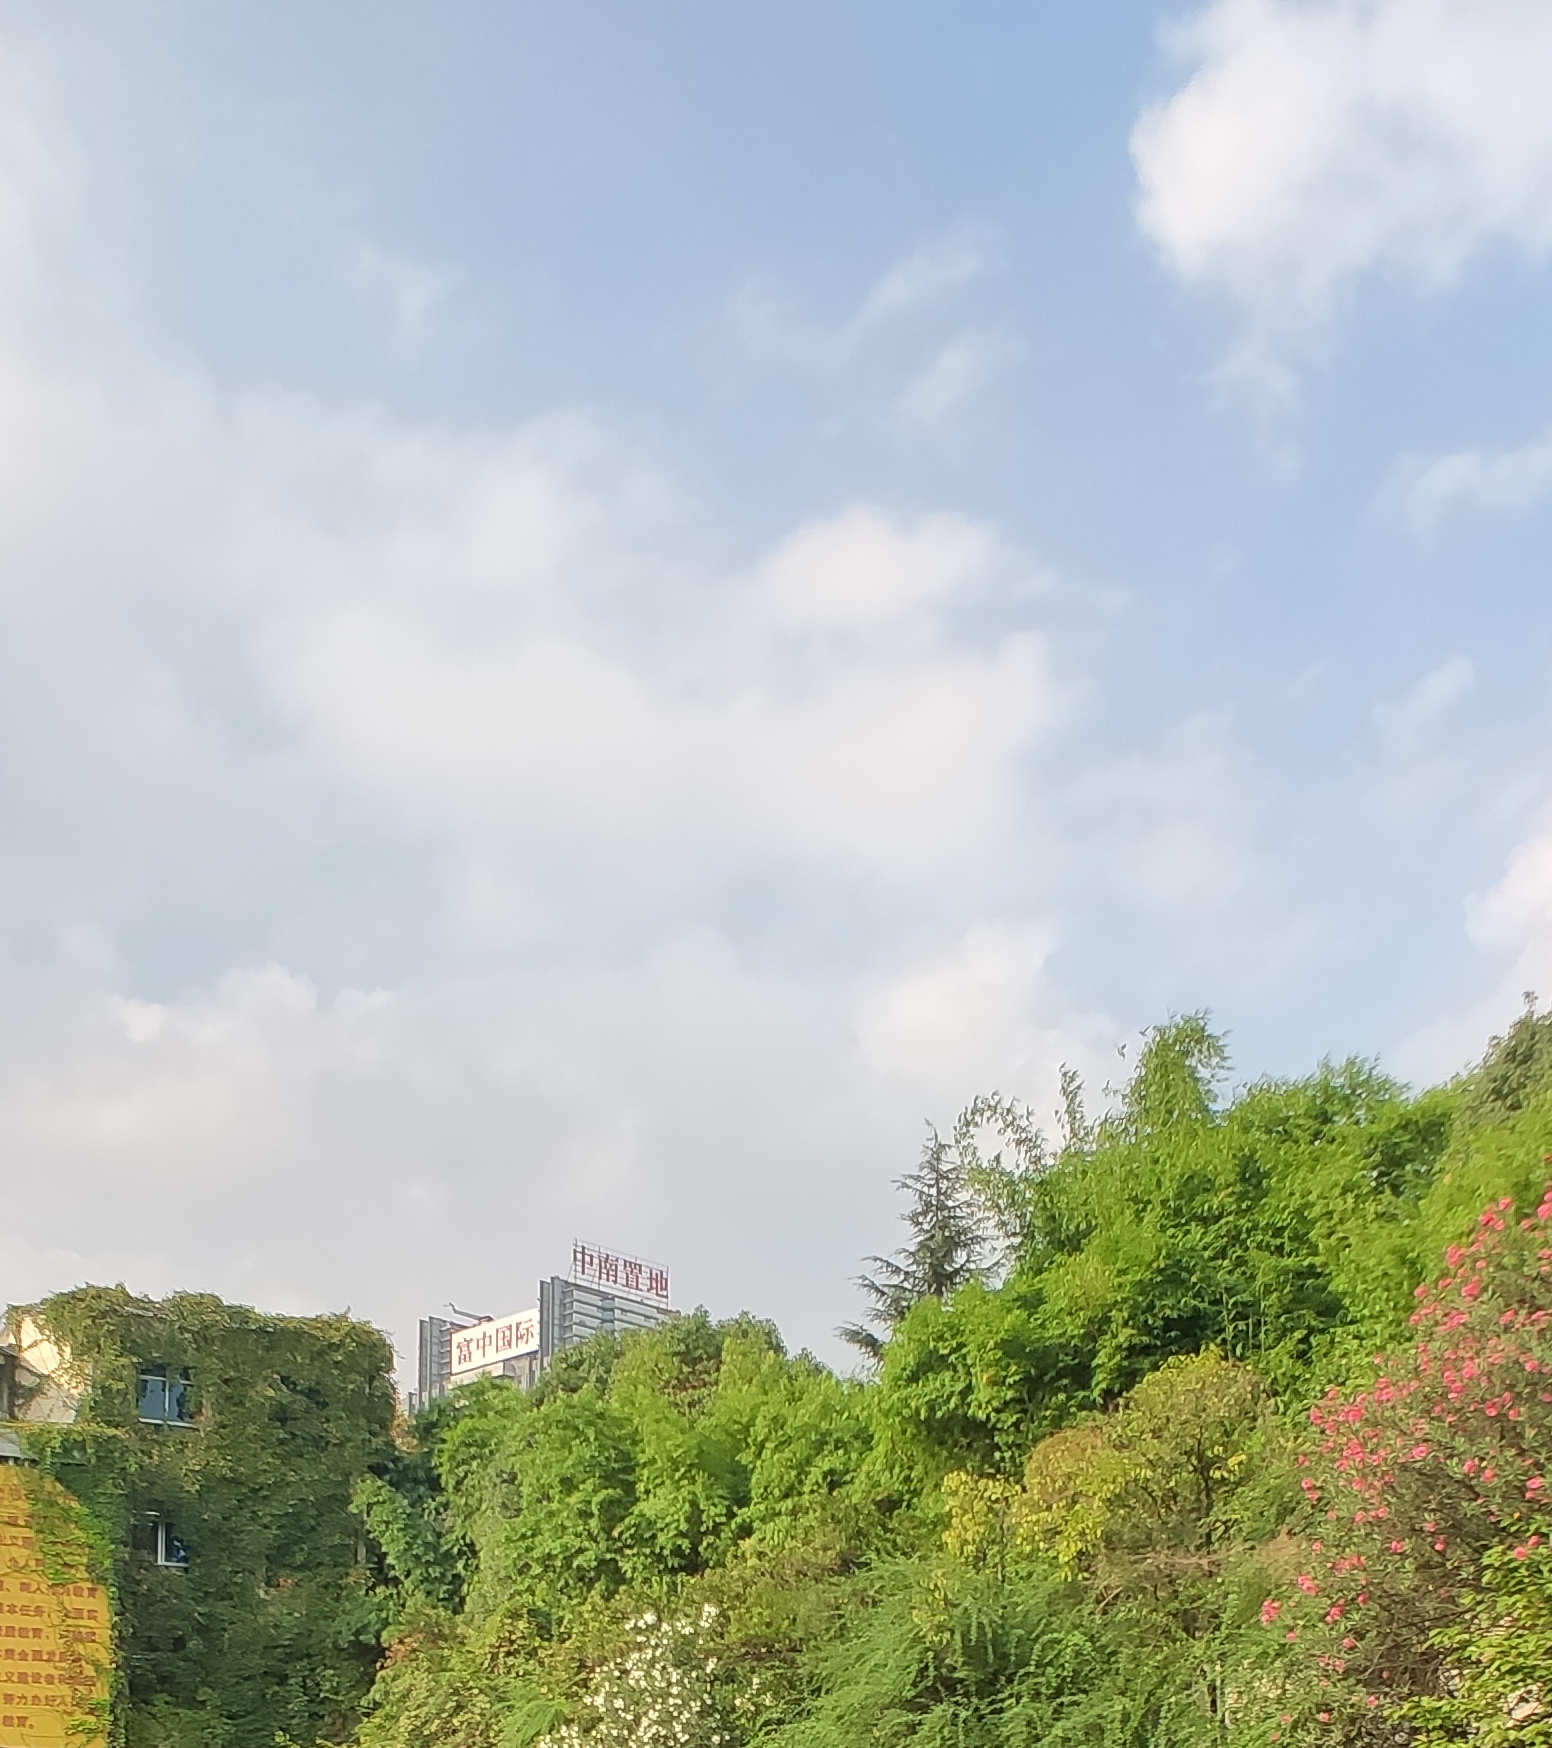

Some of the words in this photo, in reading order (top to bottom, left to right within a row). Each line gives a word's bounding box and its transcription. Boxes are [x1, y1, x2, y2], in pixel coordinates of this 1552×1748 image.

[573, 1245, 669, 1299] 中南置地
[456, 1318, 536, 1365] 富中国际
